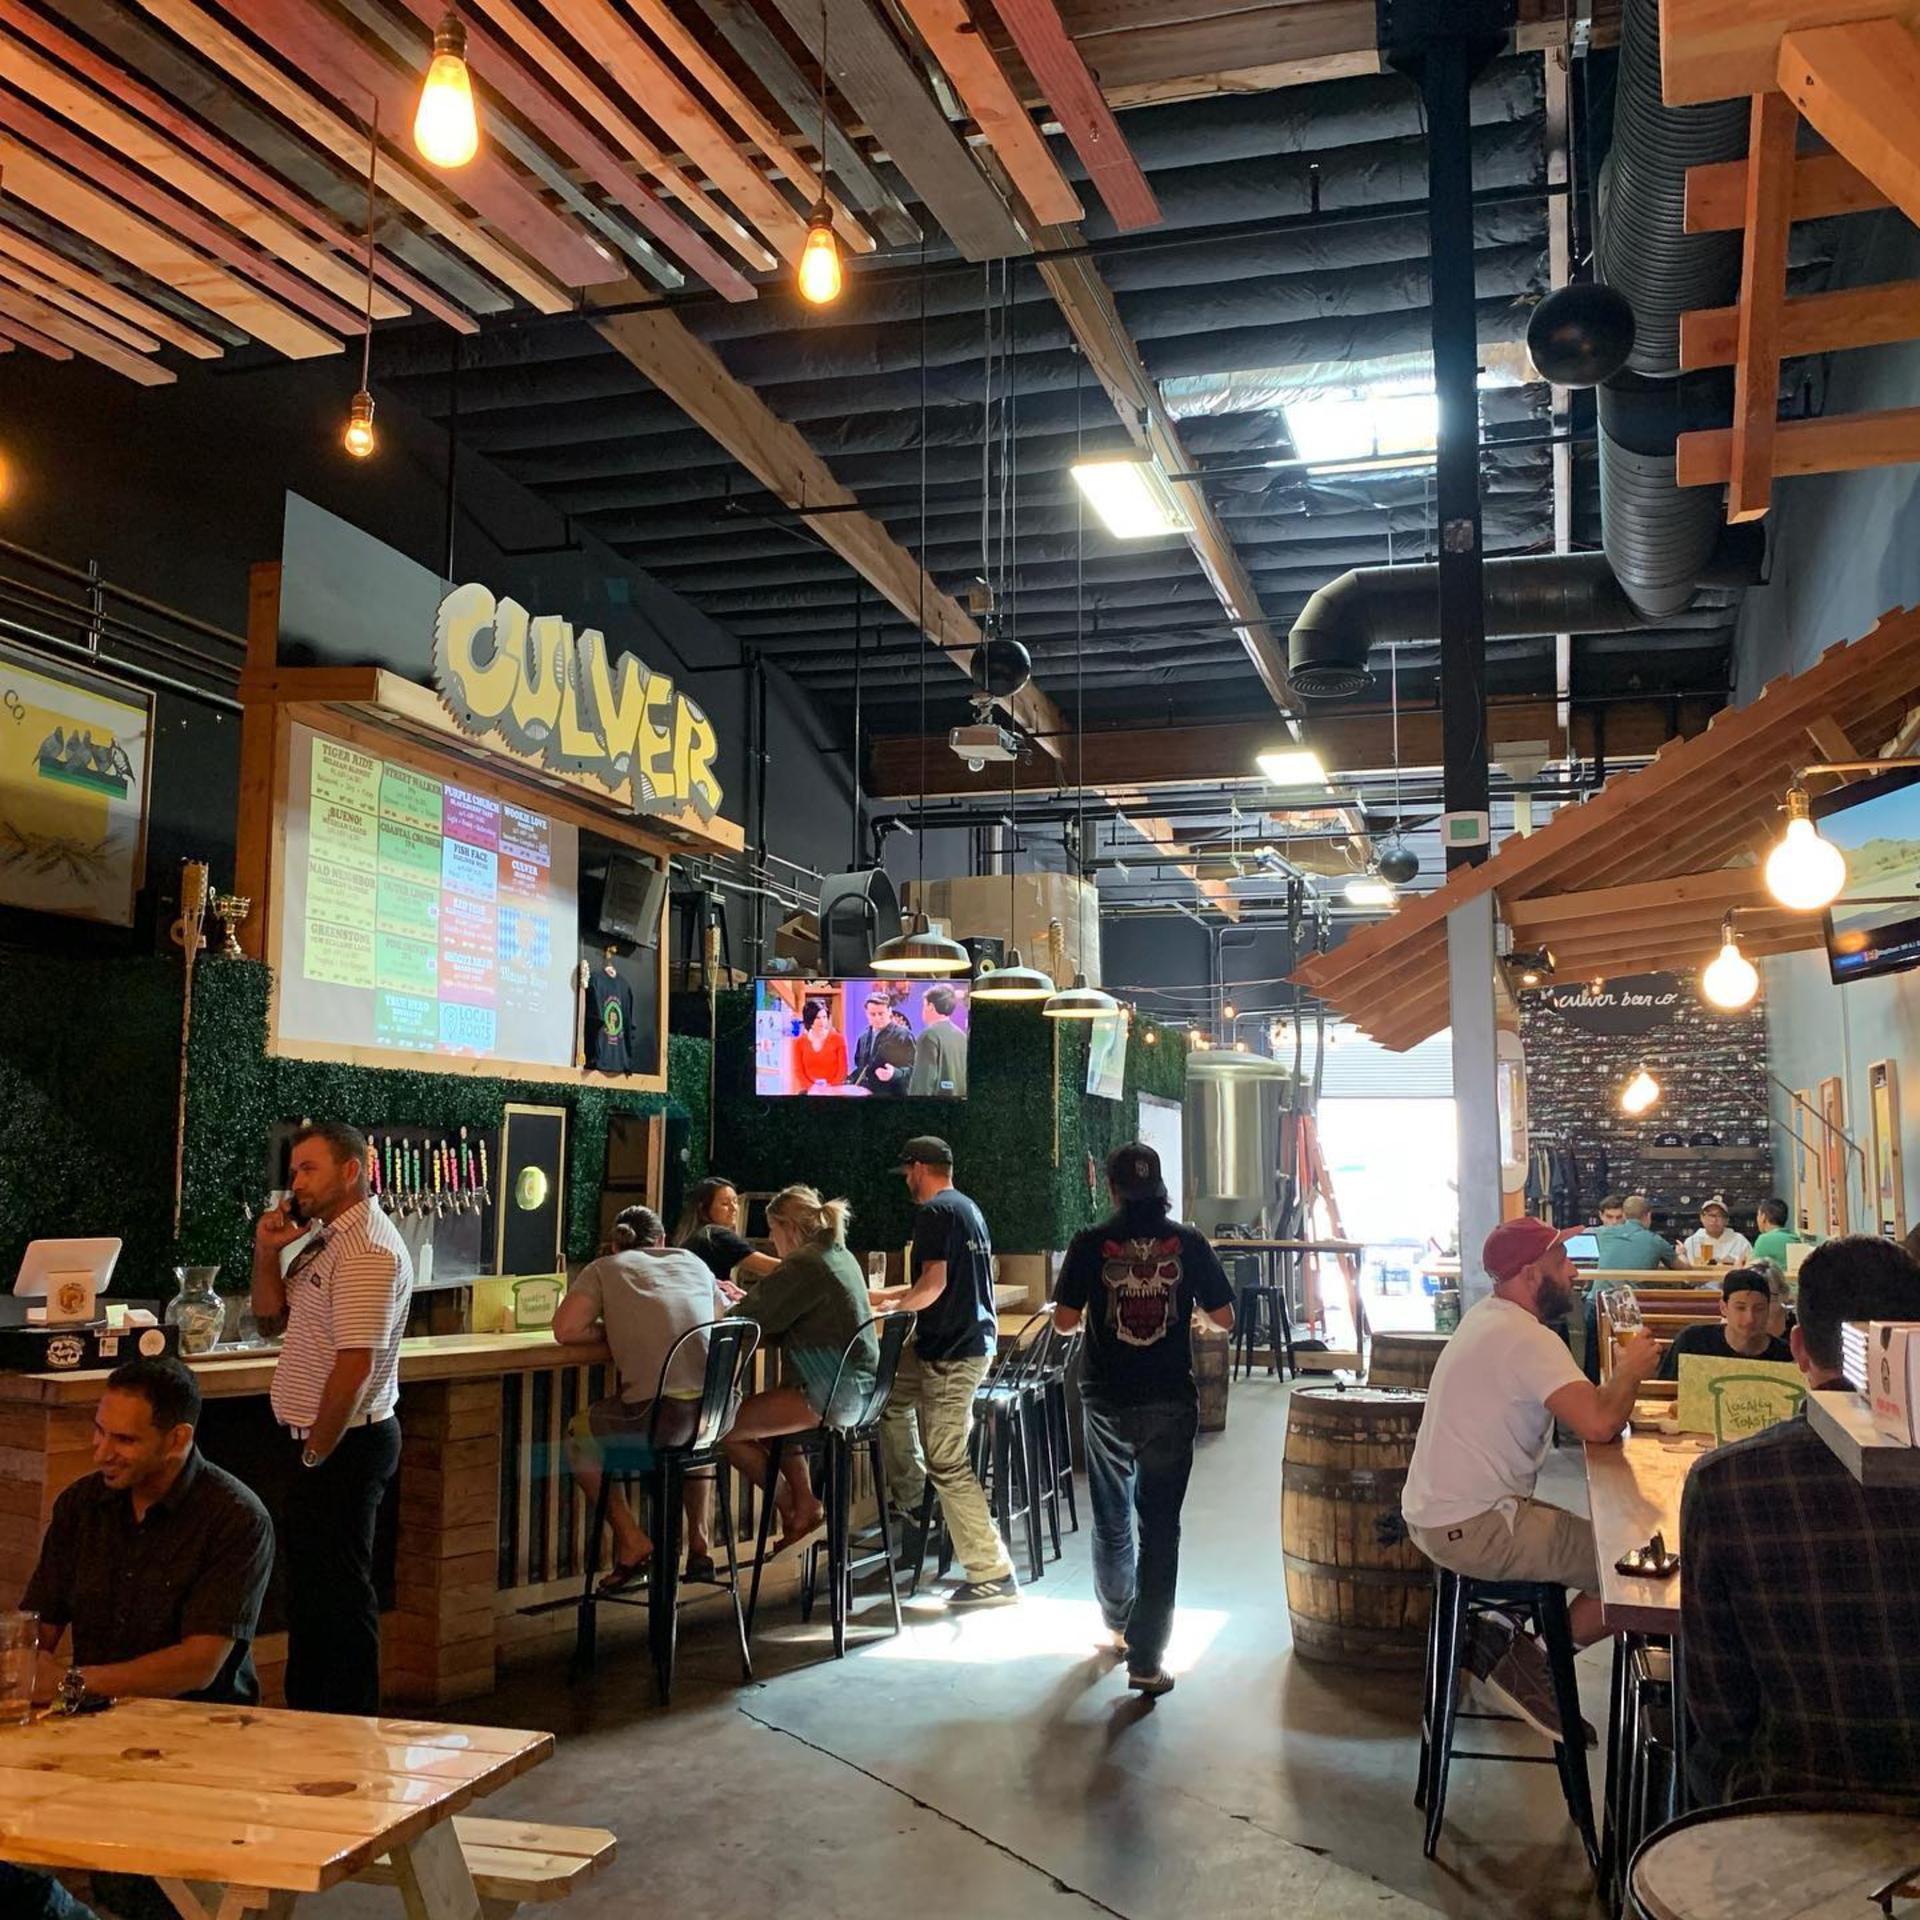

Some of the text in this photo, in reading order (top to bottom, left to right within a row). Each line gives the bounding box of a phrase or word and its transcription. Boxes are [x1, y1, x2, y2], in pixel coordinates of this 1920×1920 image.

[436, 583, 722, 815] CULVER
[322, 744, 375, 770] TIGER RIDE
[454, 843, 470, 857] FISH
[471, 849, 489, 863] FACE
[459, 1006, 492, 1025] LOCAL
[459, 1024, 492, 1041] ROOTS
